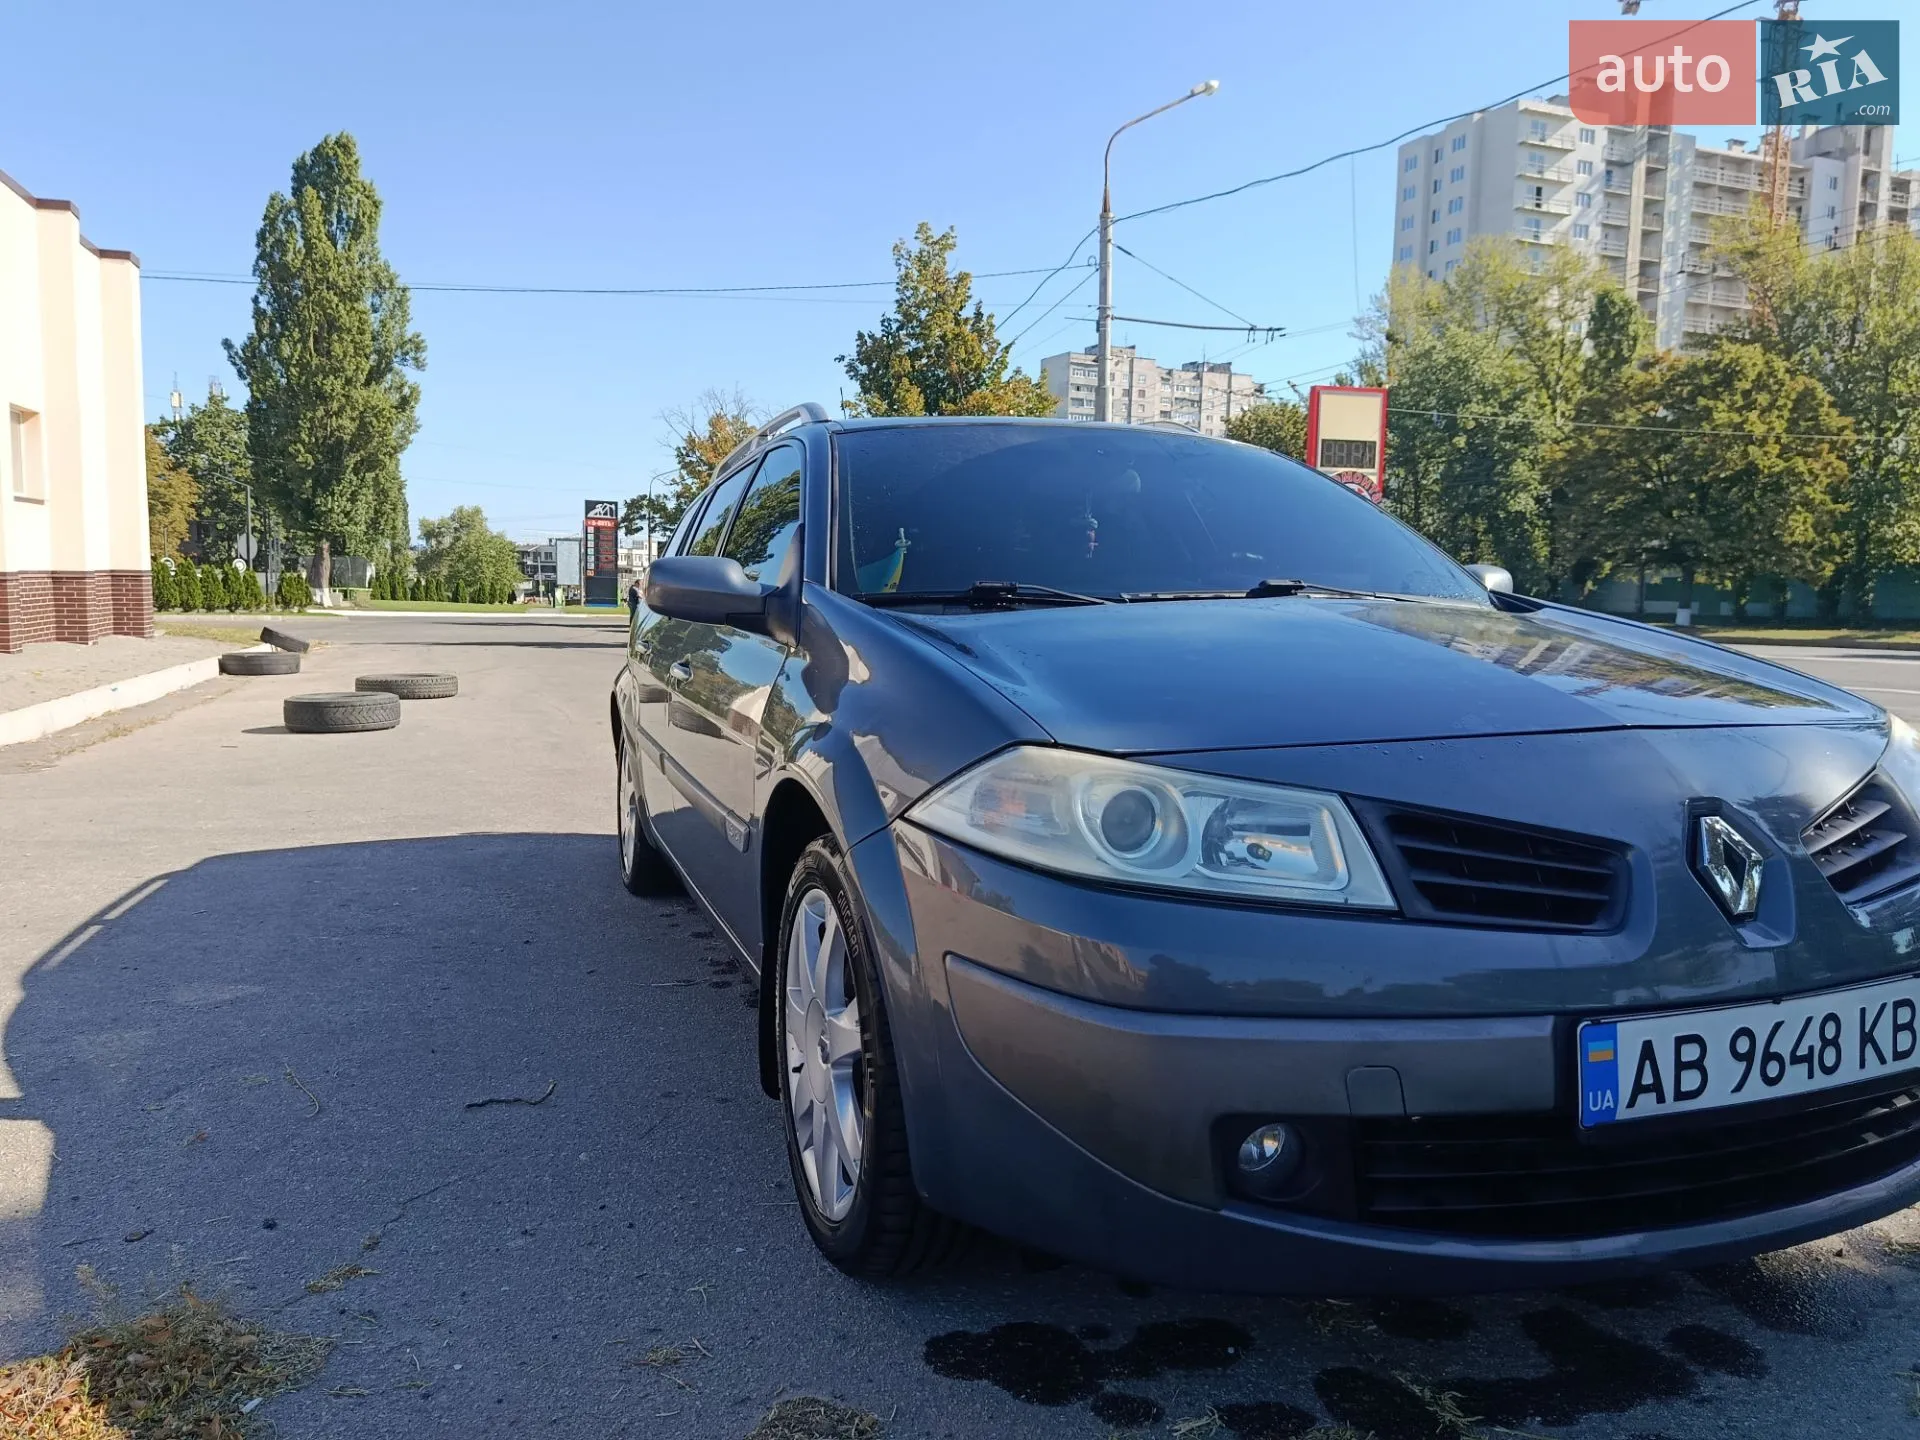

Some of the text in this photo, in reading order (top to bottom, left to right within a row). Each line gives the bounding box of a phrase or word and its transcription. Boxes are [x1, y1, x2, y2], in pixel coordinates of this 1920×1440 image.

[1625, 997, 1918, 1109] AB 9648 KB
[1588, 1090, 1614, 1112] UA
